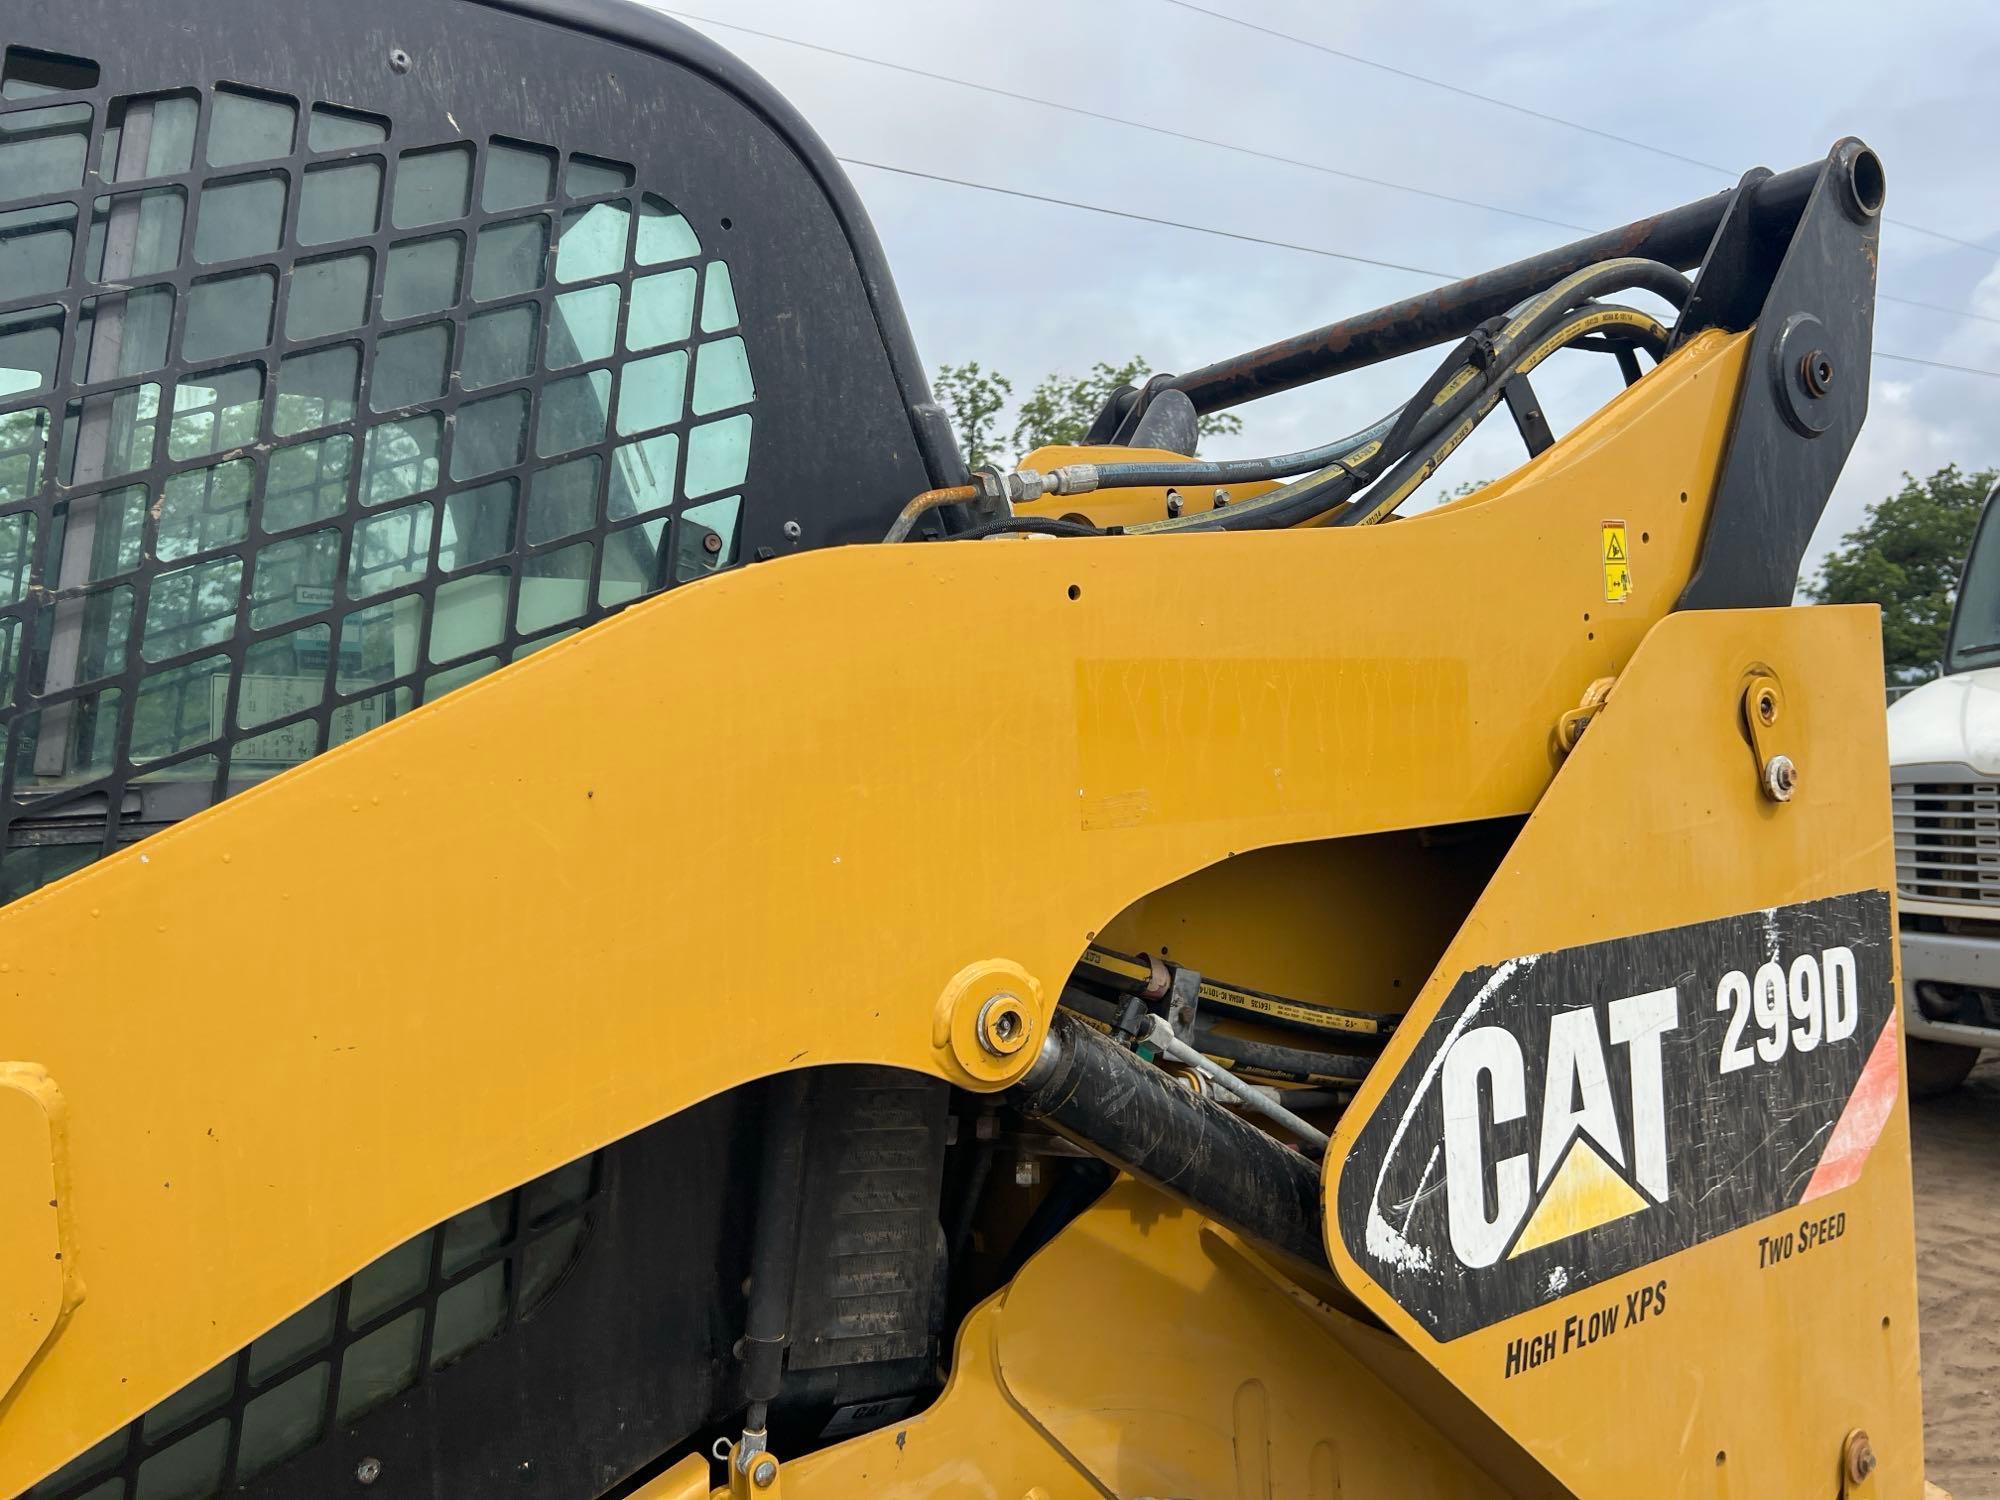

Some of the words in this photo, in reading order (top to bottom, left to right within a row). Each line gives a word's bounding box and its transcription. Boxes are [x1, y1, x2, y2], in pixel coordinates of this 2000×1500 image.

[1715, 946, 1859, 1075] 299D
[1440, 986, 1679, 1270] CAT
[1624, 1280, 1668, 1329] XPS
